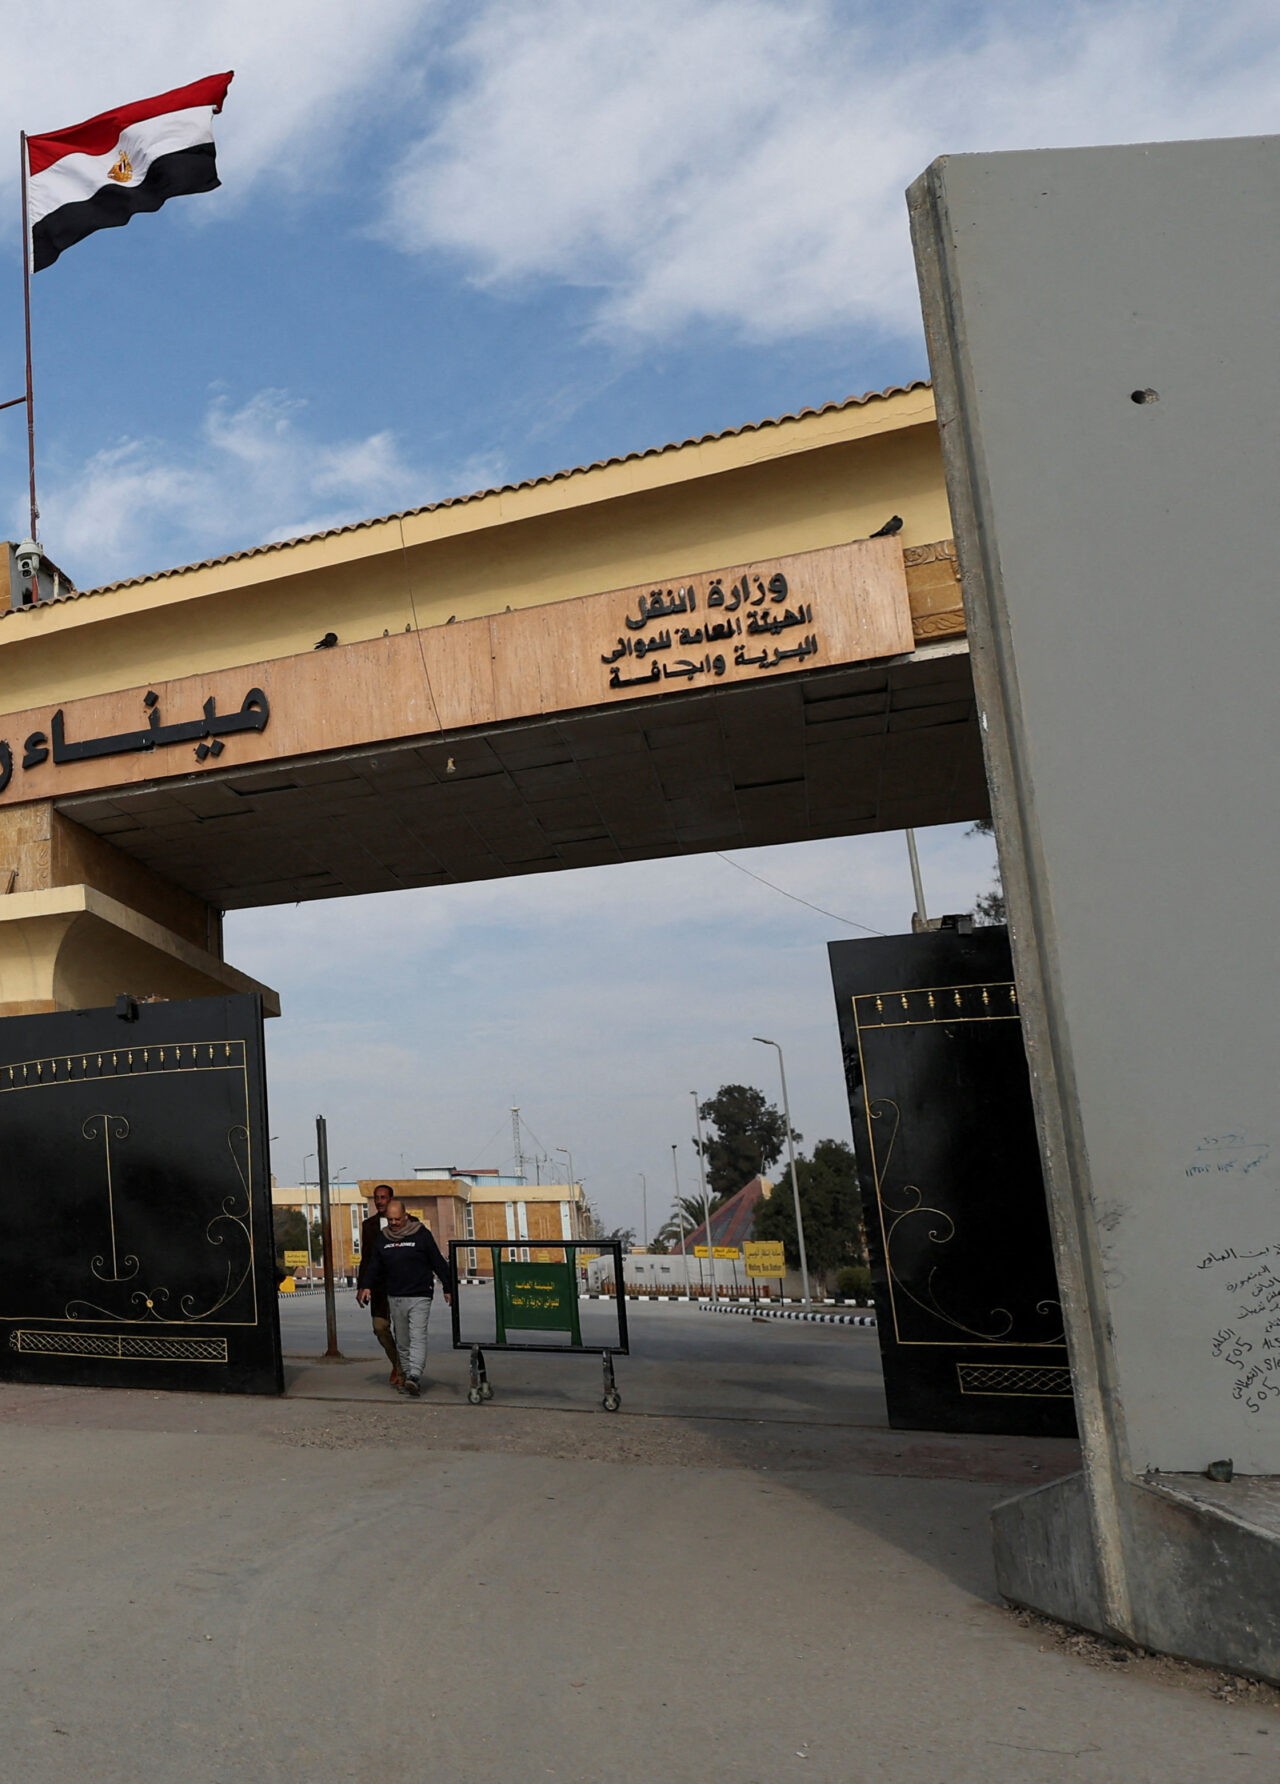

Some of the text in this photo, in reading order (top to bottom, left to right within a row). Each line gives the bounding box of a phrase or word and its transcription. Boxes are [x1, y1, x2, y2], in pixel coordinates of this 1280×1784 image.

[625, 572, 788, 630] وزارة النقل
[746, 602, 813, 636] الهيئة
[674, 616, 742, 646] العامة
[609, 633, 819, 690] البرية والجافة
[22, 687, 270, 770] ميناء
[1225, 1336, 1253, 1370] 505
[1245, 1376, 1280, 1413] 505
